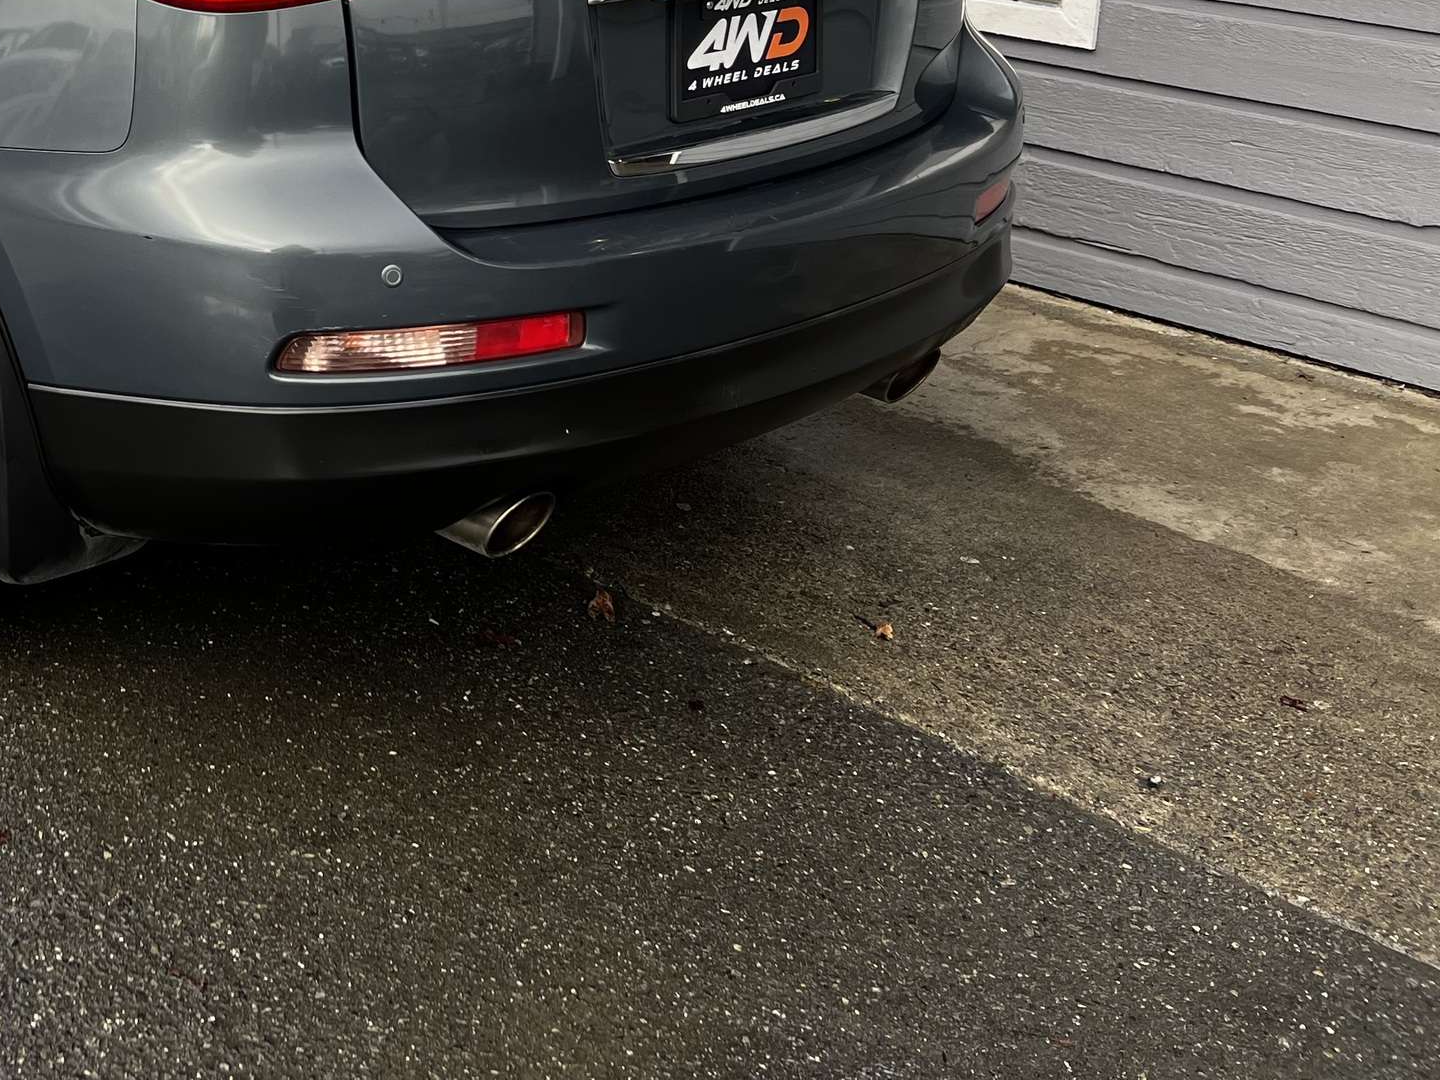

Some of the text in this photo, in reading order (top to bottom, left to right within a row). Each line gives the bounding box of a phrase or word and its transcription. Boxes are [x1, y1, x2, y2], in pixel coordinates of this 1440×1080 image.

[686, 6, 809, 72] 4WD
[688, 59, 800, 91] 4 WHEEL DEALS
[720, 93, 786, 113] 4WHEELDEALS.CA
